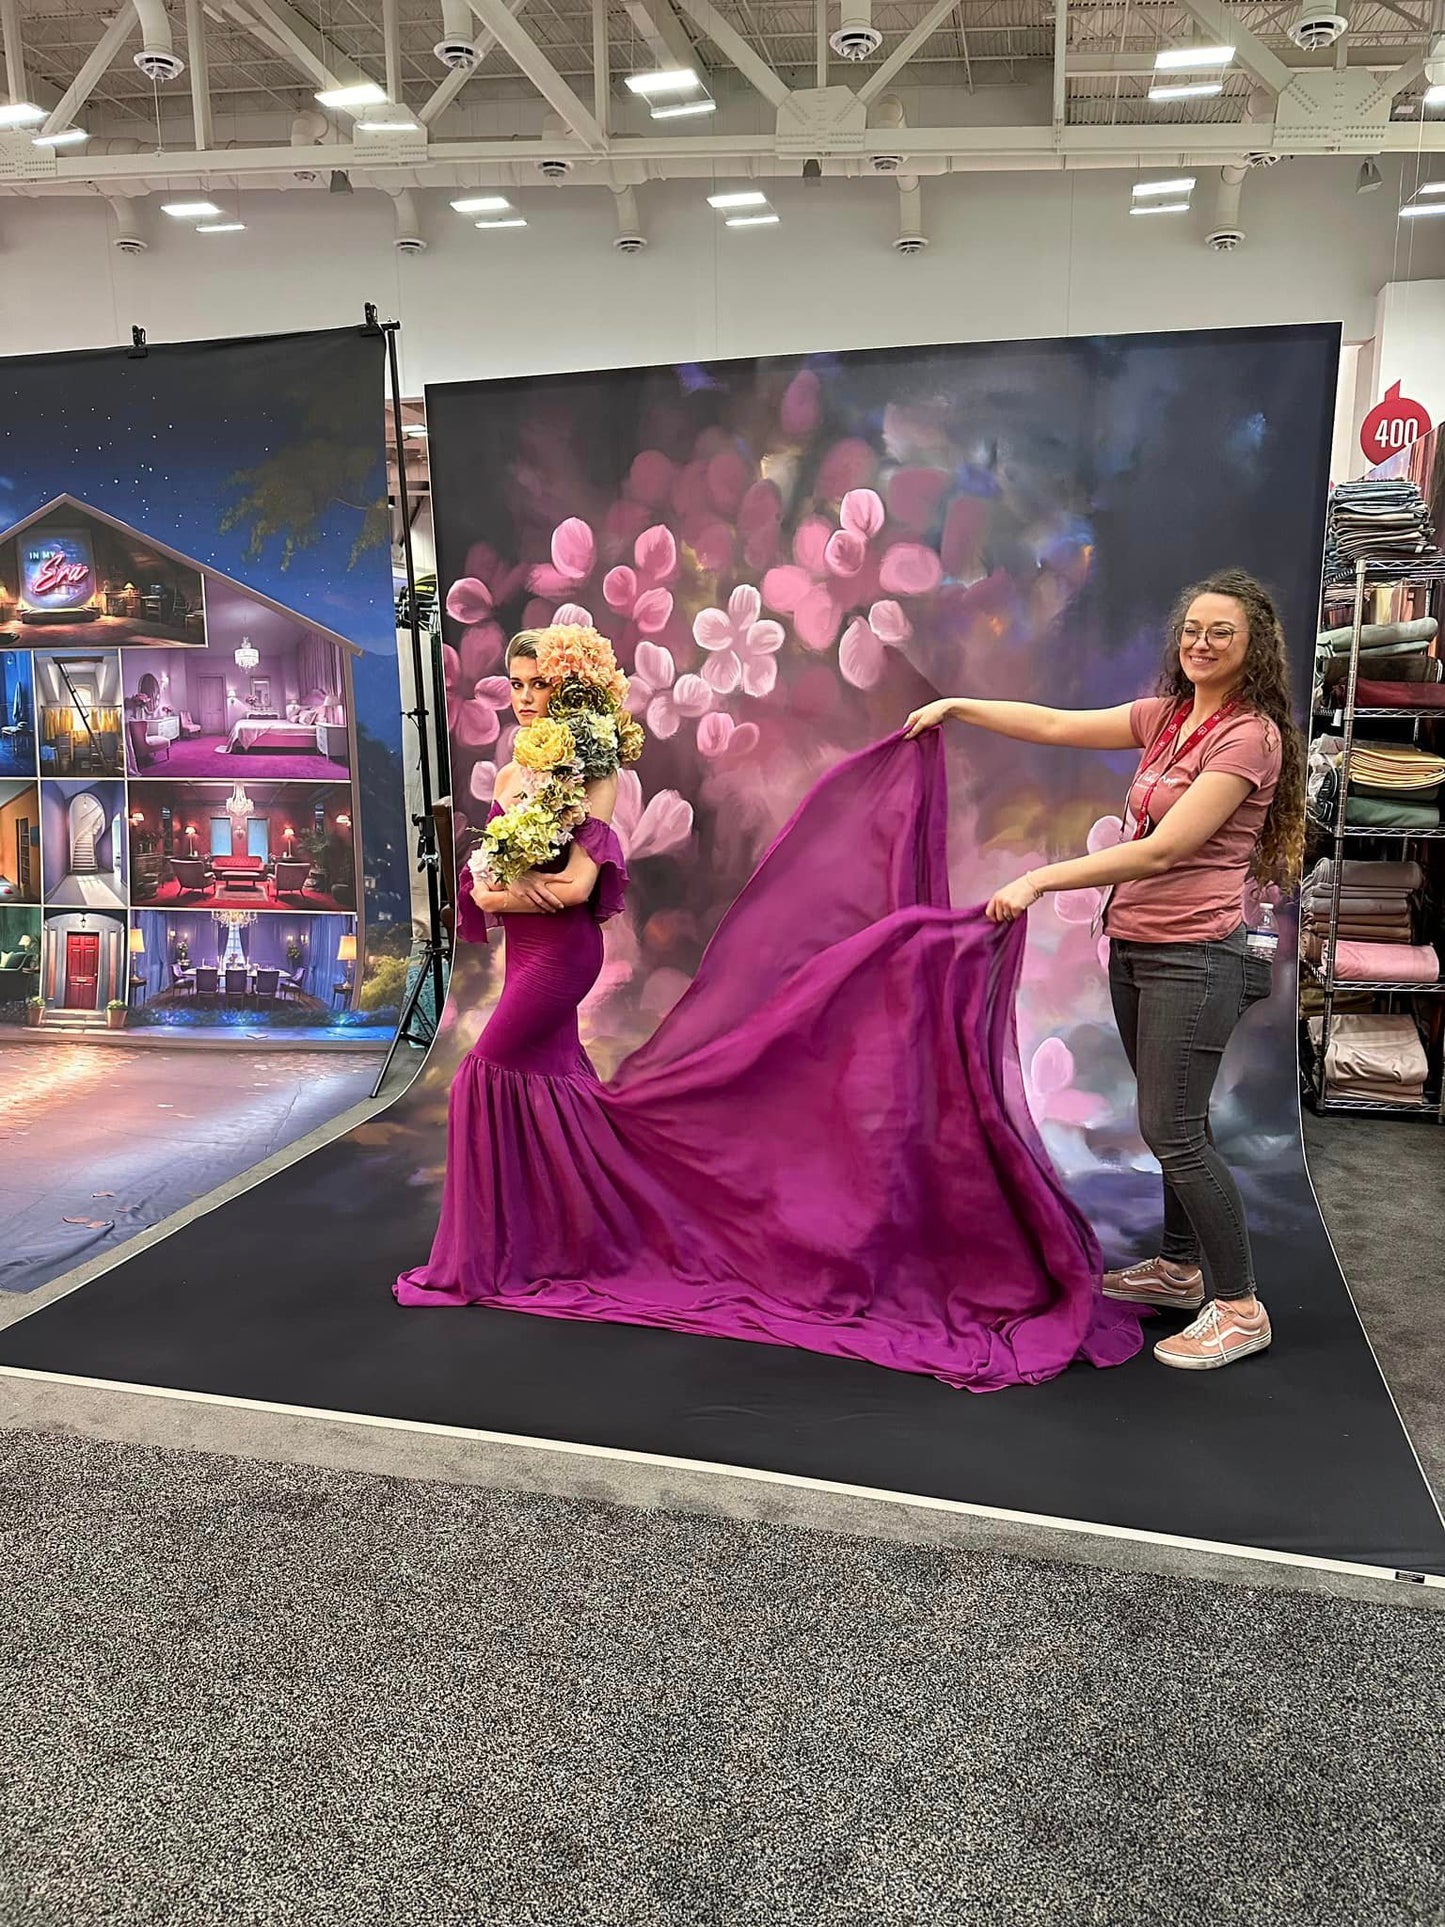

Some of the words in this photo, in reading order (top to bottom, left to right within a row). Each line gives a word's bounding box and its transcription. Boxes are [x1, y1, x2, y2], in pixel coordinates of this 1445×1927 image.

[1374, 418, 1418, 448] 400
[29, 551, 39, 560] IN
[42, 551, 56, 559] MY
[34, 551, 89, 593] Era
